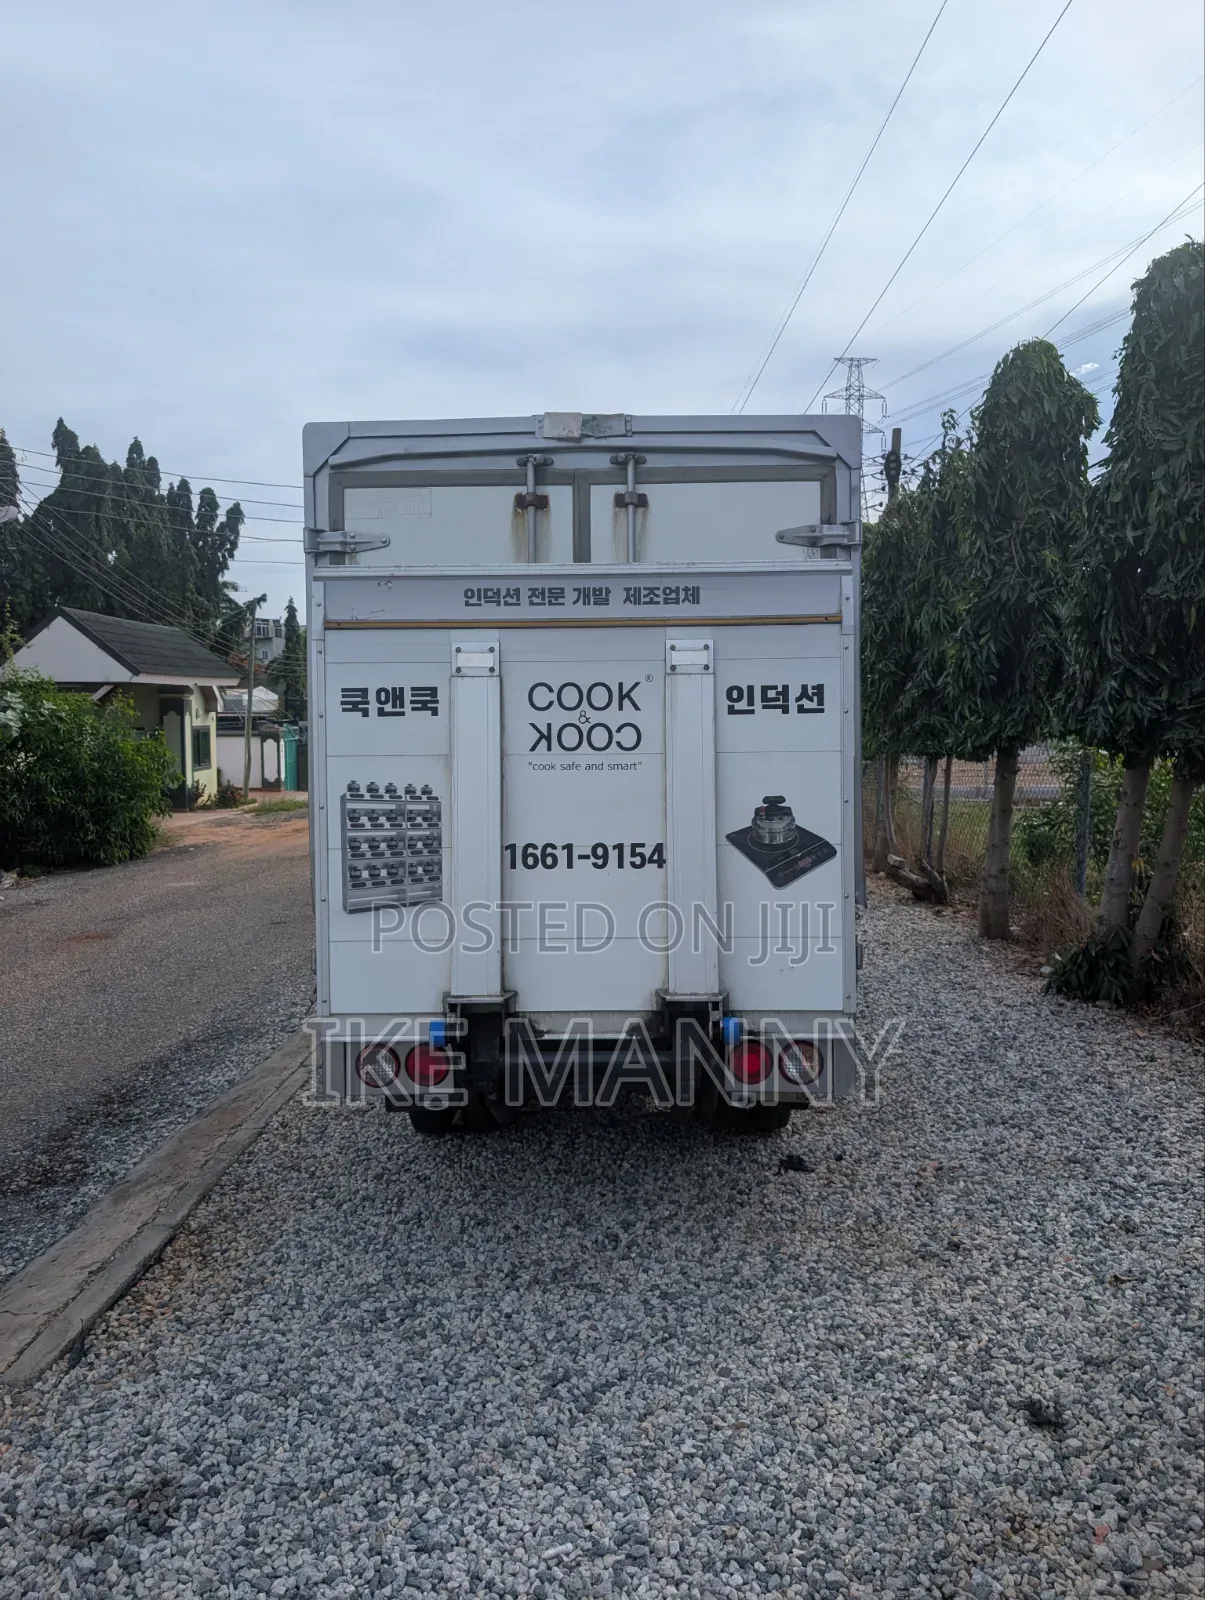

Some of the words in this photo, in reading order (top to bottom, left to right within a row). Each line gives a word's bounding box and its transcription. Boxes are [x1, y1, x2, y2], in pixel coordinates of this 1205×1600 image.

[463, 587, 521, 607] 인덕션
[527, 586, 566, 606] 전문
[572, 586, 612, 606] 개발
[622, 585, 701, 606] 제조업체
[340, 686, 440, 717] 쿡앤쿡
[527, 681, 642, 712] COOK
[725, 682, 827, 715] 인덕션
[578, 709, 592, 724] &
[528, 761, 557, 771] "cook
[560, 761, 582, 771] safe
[584, 761, 604, 771] and
[607, 761, 643, 771] smart"
[503, 841, 667, 872] 1661-9154
